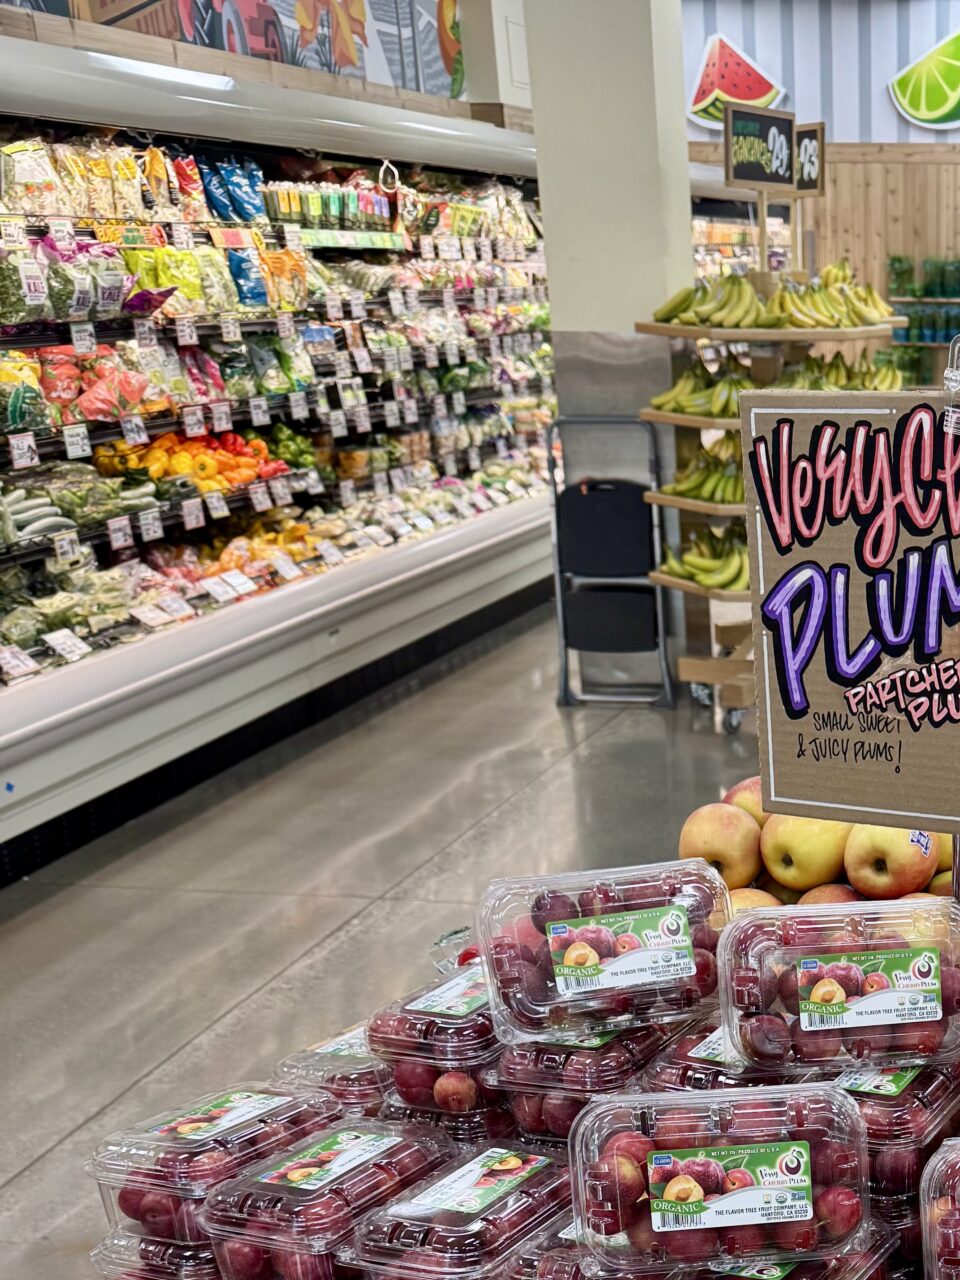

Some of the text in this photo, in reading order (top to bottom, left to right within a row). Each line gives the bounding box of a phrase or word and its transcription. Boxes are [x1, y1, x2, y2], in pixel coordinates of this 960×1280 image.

[844, 668, 906, 715] PART
[813, 712, 901, 734] SMALL SWEET
[797, 733, 807, 759] &
[809, 737, 850, 762] JUICY
[556, 965, 597, 975] ORGANIC
[802, 1002, 842, 1013] ORGANIC
[653, 1200, 700, 1212] ORGANIC
